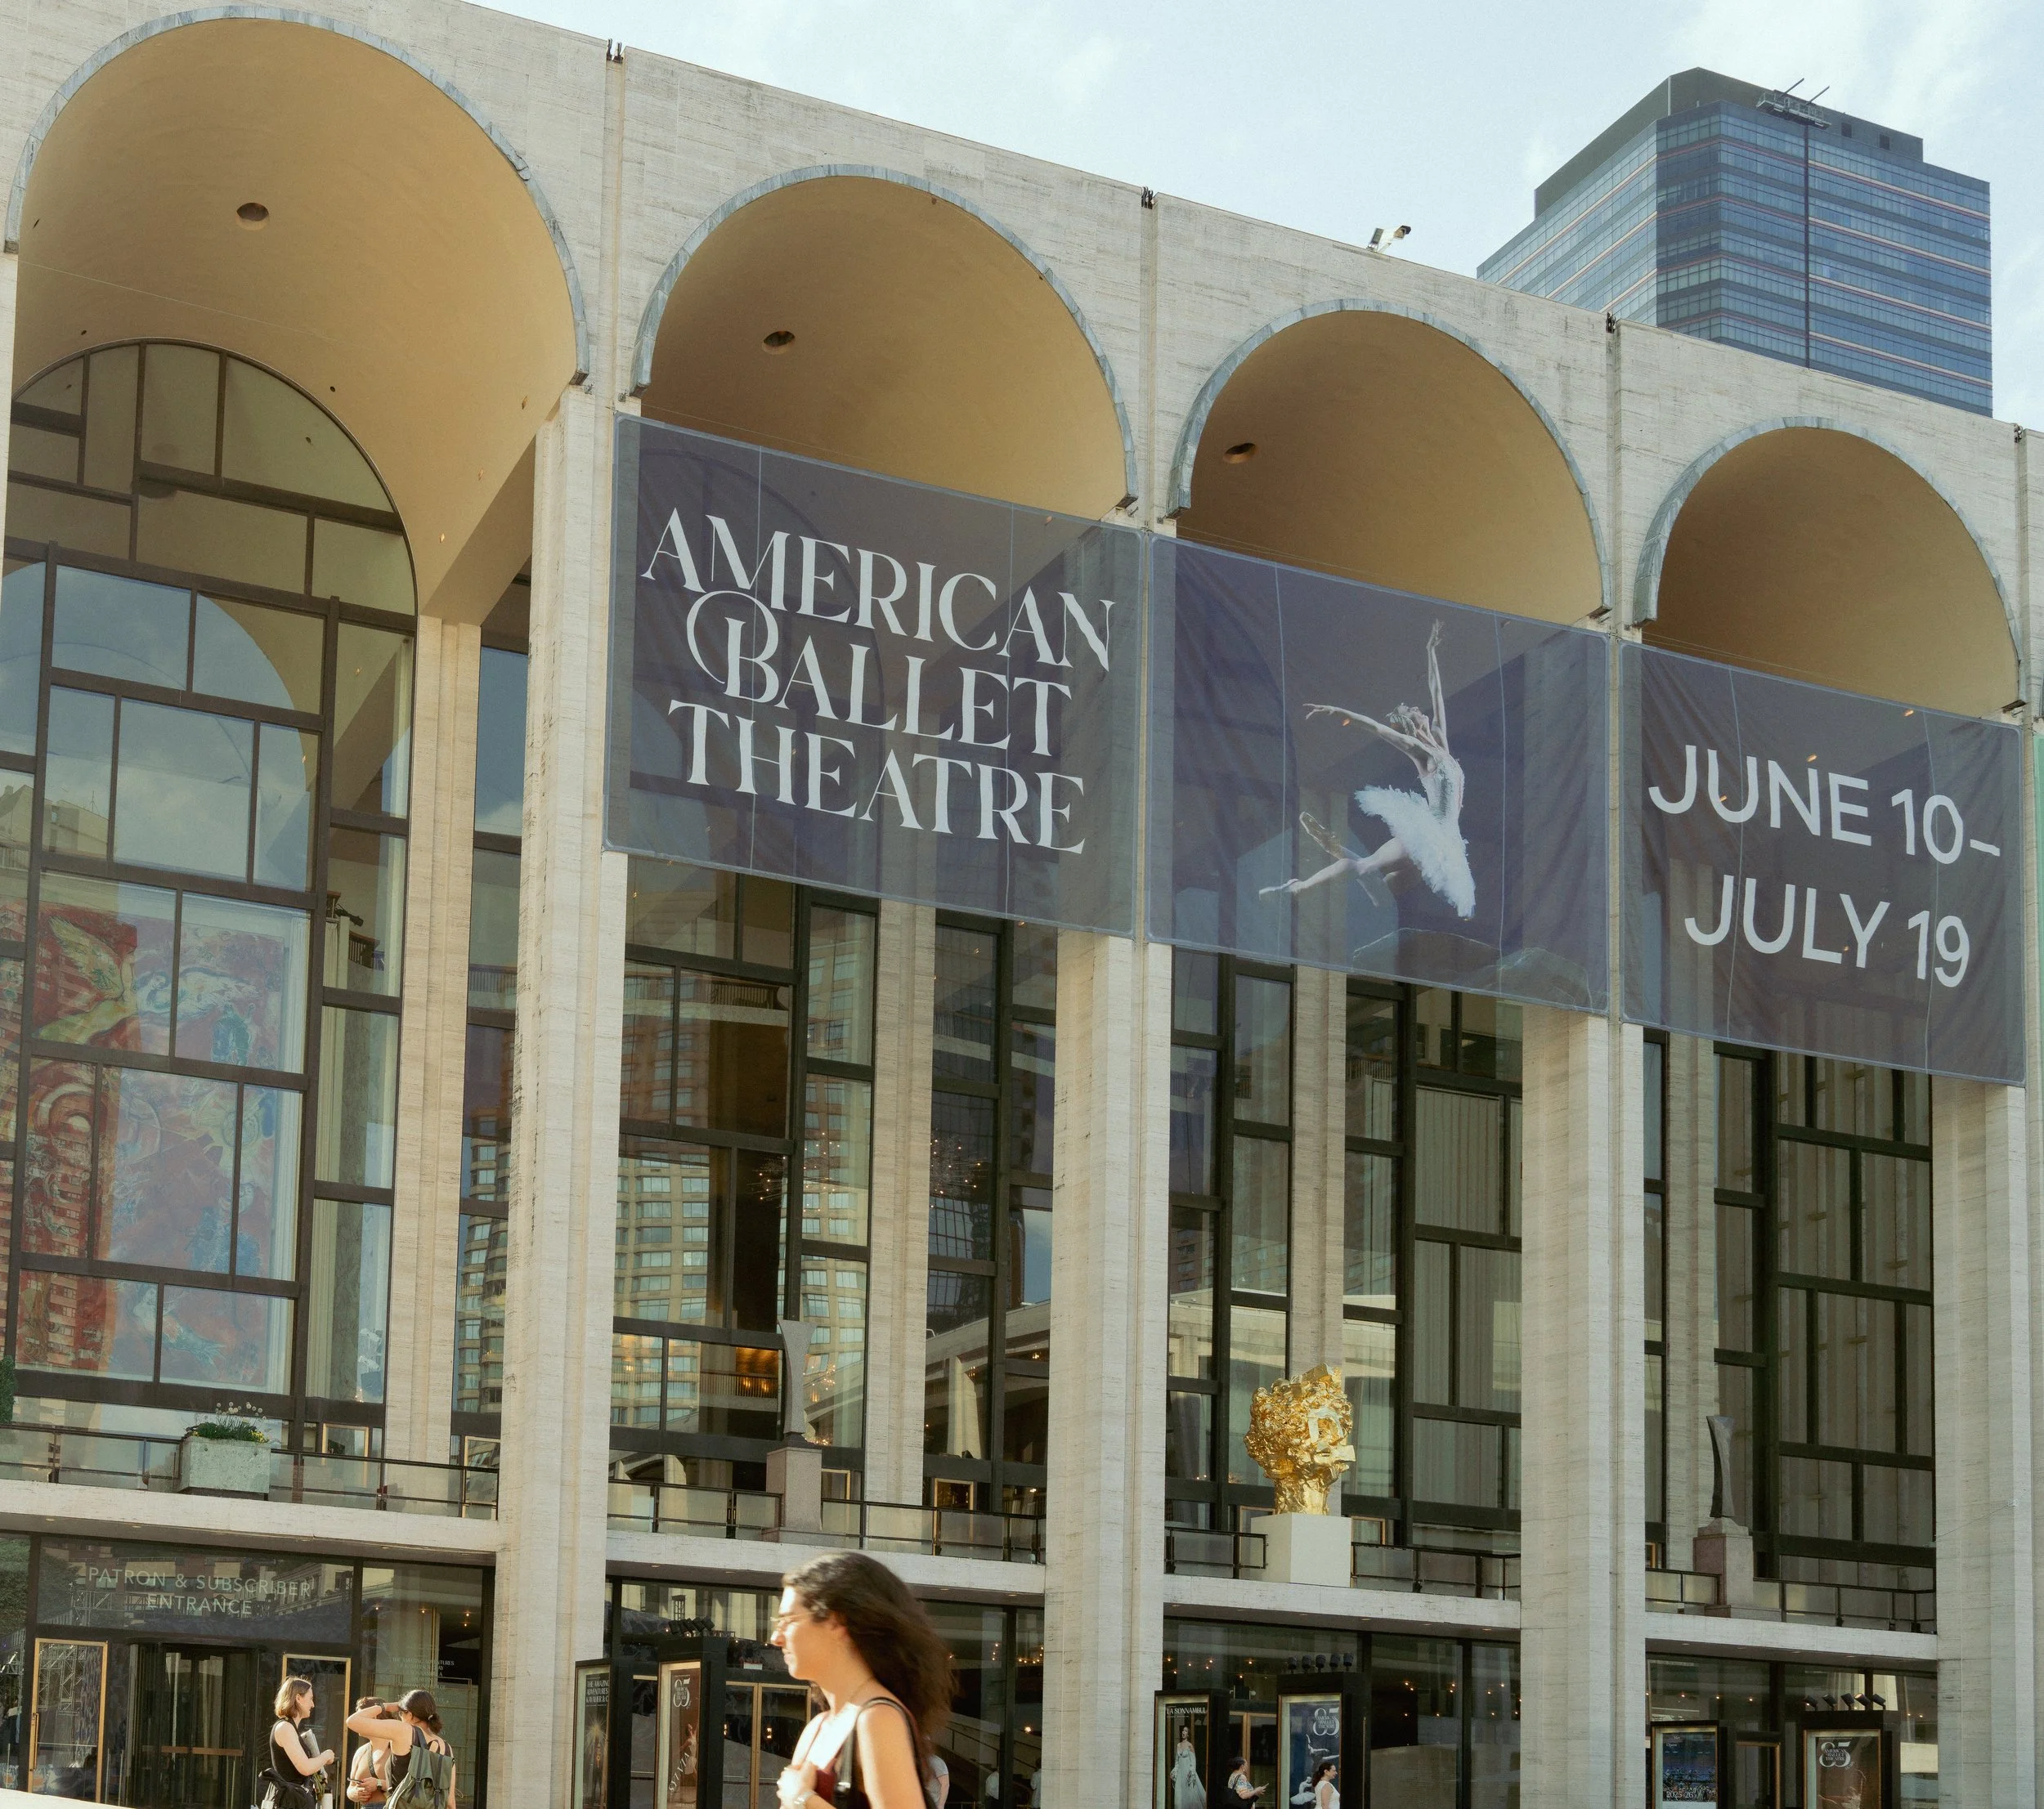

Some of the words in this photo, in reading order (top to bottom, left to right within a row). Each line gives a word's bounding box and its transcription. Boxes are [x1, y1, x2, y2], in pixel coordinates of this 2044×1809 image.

[641, 508, 1115, 672] AMERICAN
[686, 590, 1073, 757] BALLET
[667, 699, 1086, 854] THEATRE
[1648, 745, 1871, 846] JUNE
[1684, 874, 1890, 969] JULY
[1907, 910, 1970, 987] 19
[88, 1567, 165, 1587] PATRON
[175, 1574, 187, 1588] &
[196, 1574, 311, 1596] SUBSCRIBER
[147, 1593, 253, 1614] ENTRANCE
[674, 1677, 690, 1708] 85
[1313, 1707, 1340, 1736] 85
[669, 1753, 690, 1793] SYLVIA
[1819, 1740, 1851, 1767] 85
